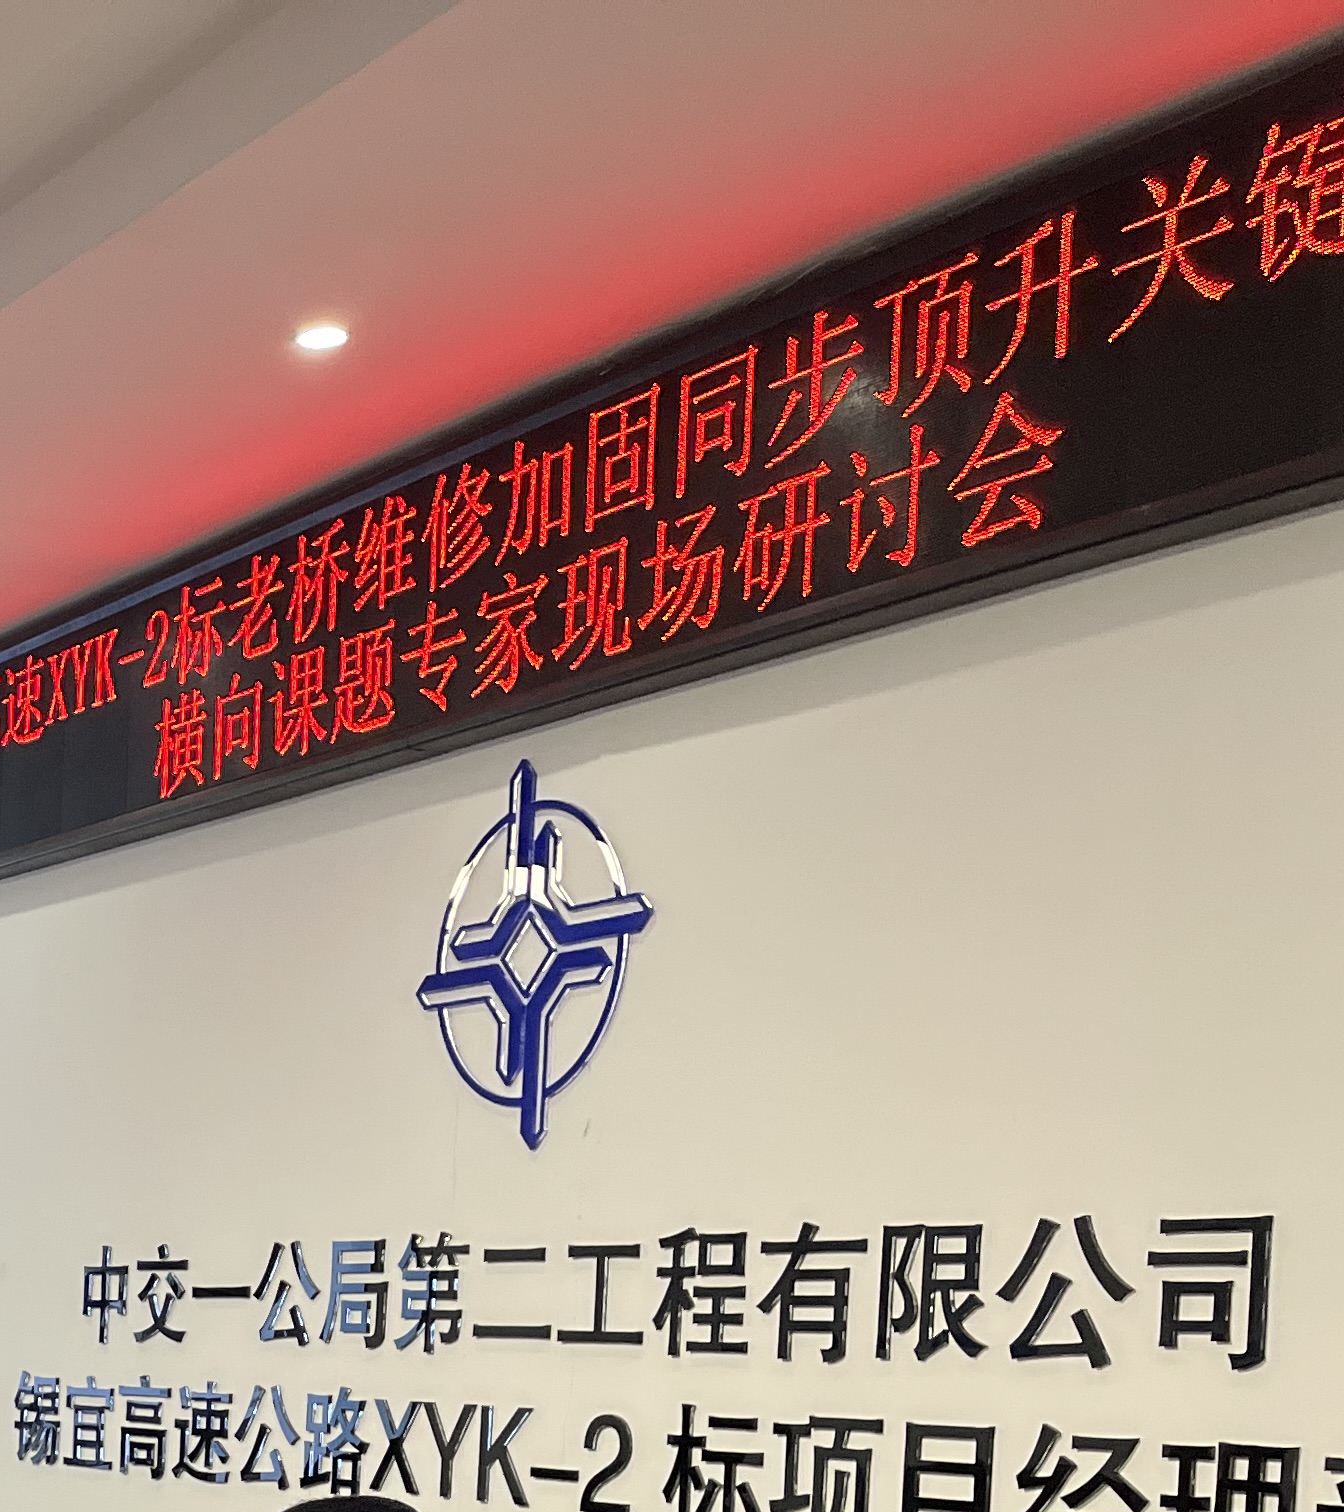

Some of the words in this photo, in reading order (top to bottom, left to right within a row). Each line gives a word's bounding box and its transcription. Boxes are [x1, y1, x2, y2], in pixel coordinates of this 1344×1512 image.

[154, 392, 1064, 799] 横向课题专家现场研讨会
[80, 1213, 1276, 1372] 中交一公局第二工程有限公司
